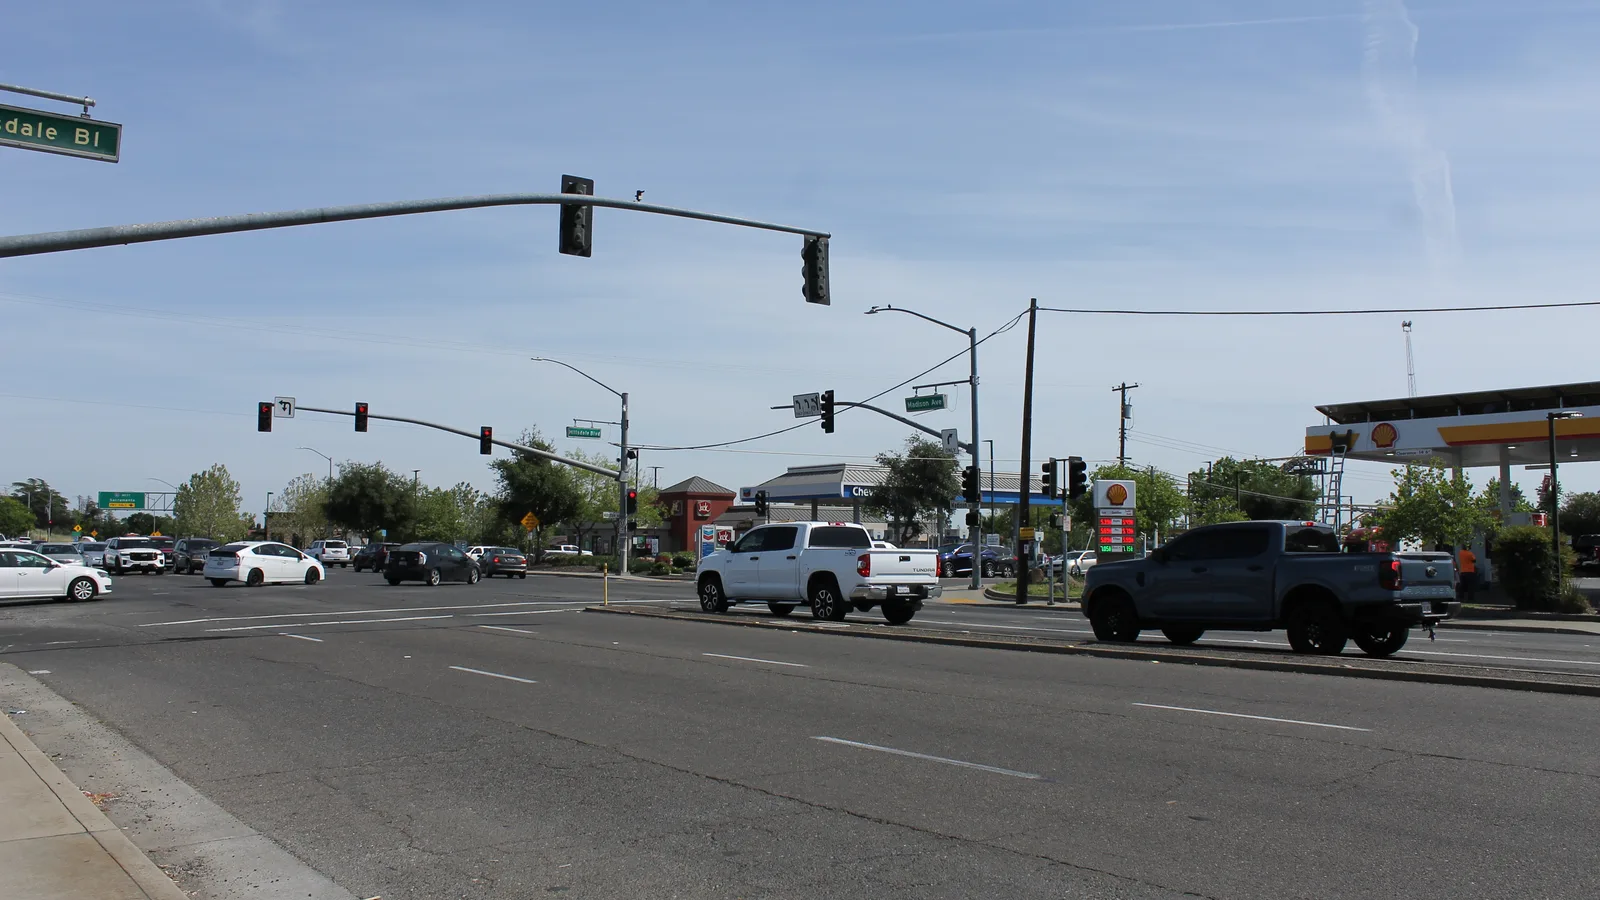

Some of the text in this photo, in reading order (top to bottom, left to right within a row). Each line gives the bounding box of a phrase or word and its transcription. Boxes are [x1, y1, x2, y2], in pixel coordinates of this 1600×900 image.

[0, 118, 99, 147] dale Bl
[852, 486, 874, 497] Chev
